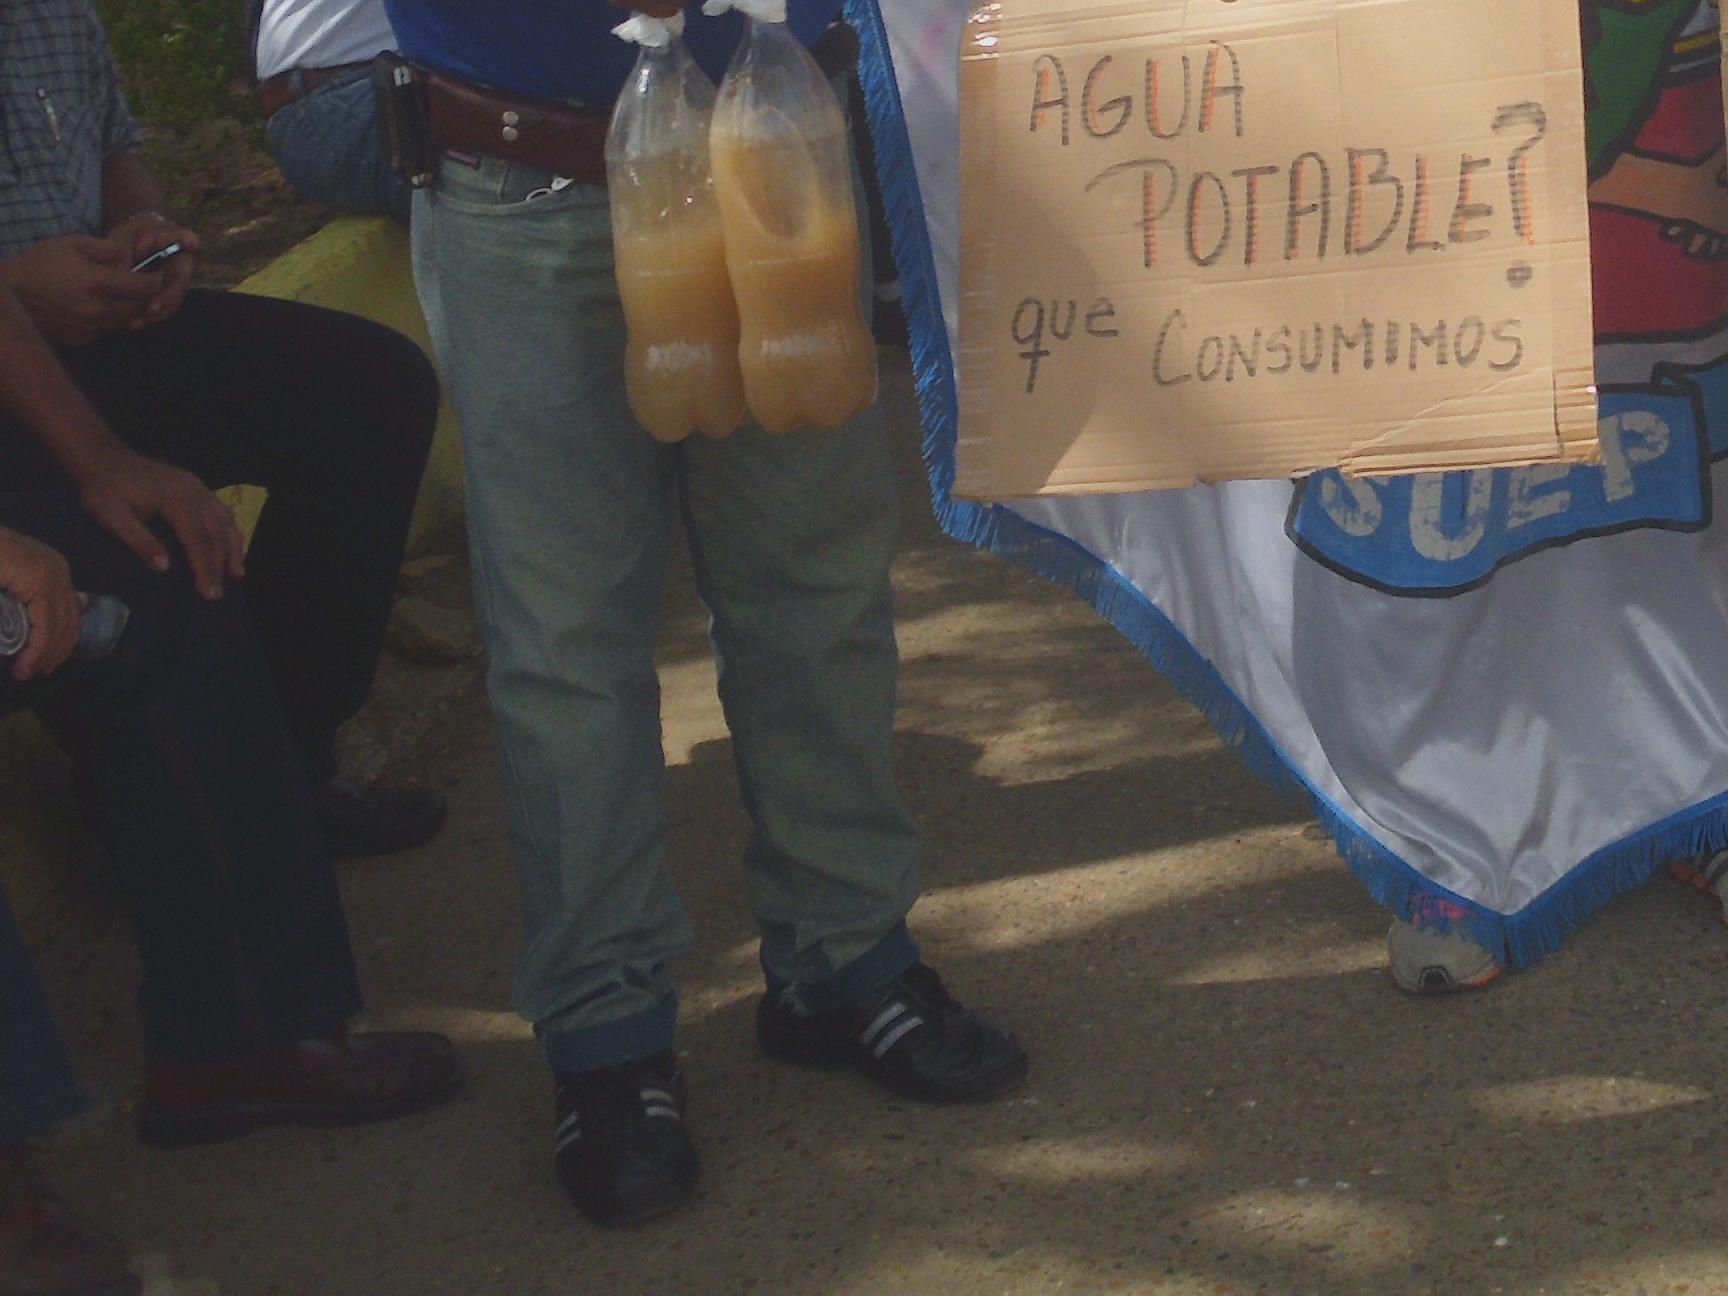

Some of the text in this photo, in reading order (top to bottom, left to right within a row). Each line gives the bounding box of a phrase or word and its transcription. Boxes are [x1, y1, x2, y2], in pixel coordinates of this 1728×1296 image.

[1030, 40, 1244, 146] AGUA
[1085, 101, 1548, 288] POTABLE?
[1011, 297, 1120, 394] que
[1152, 308, 1525, 386] CONSUMIMOS
